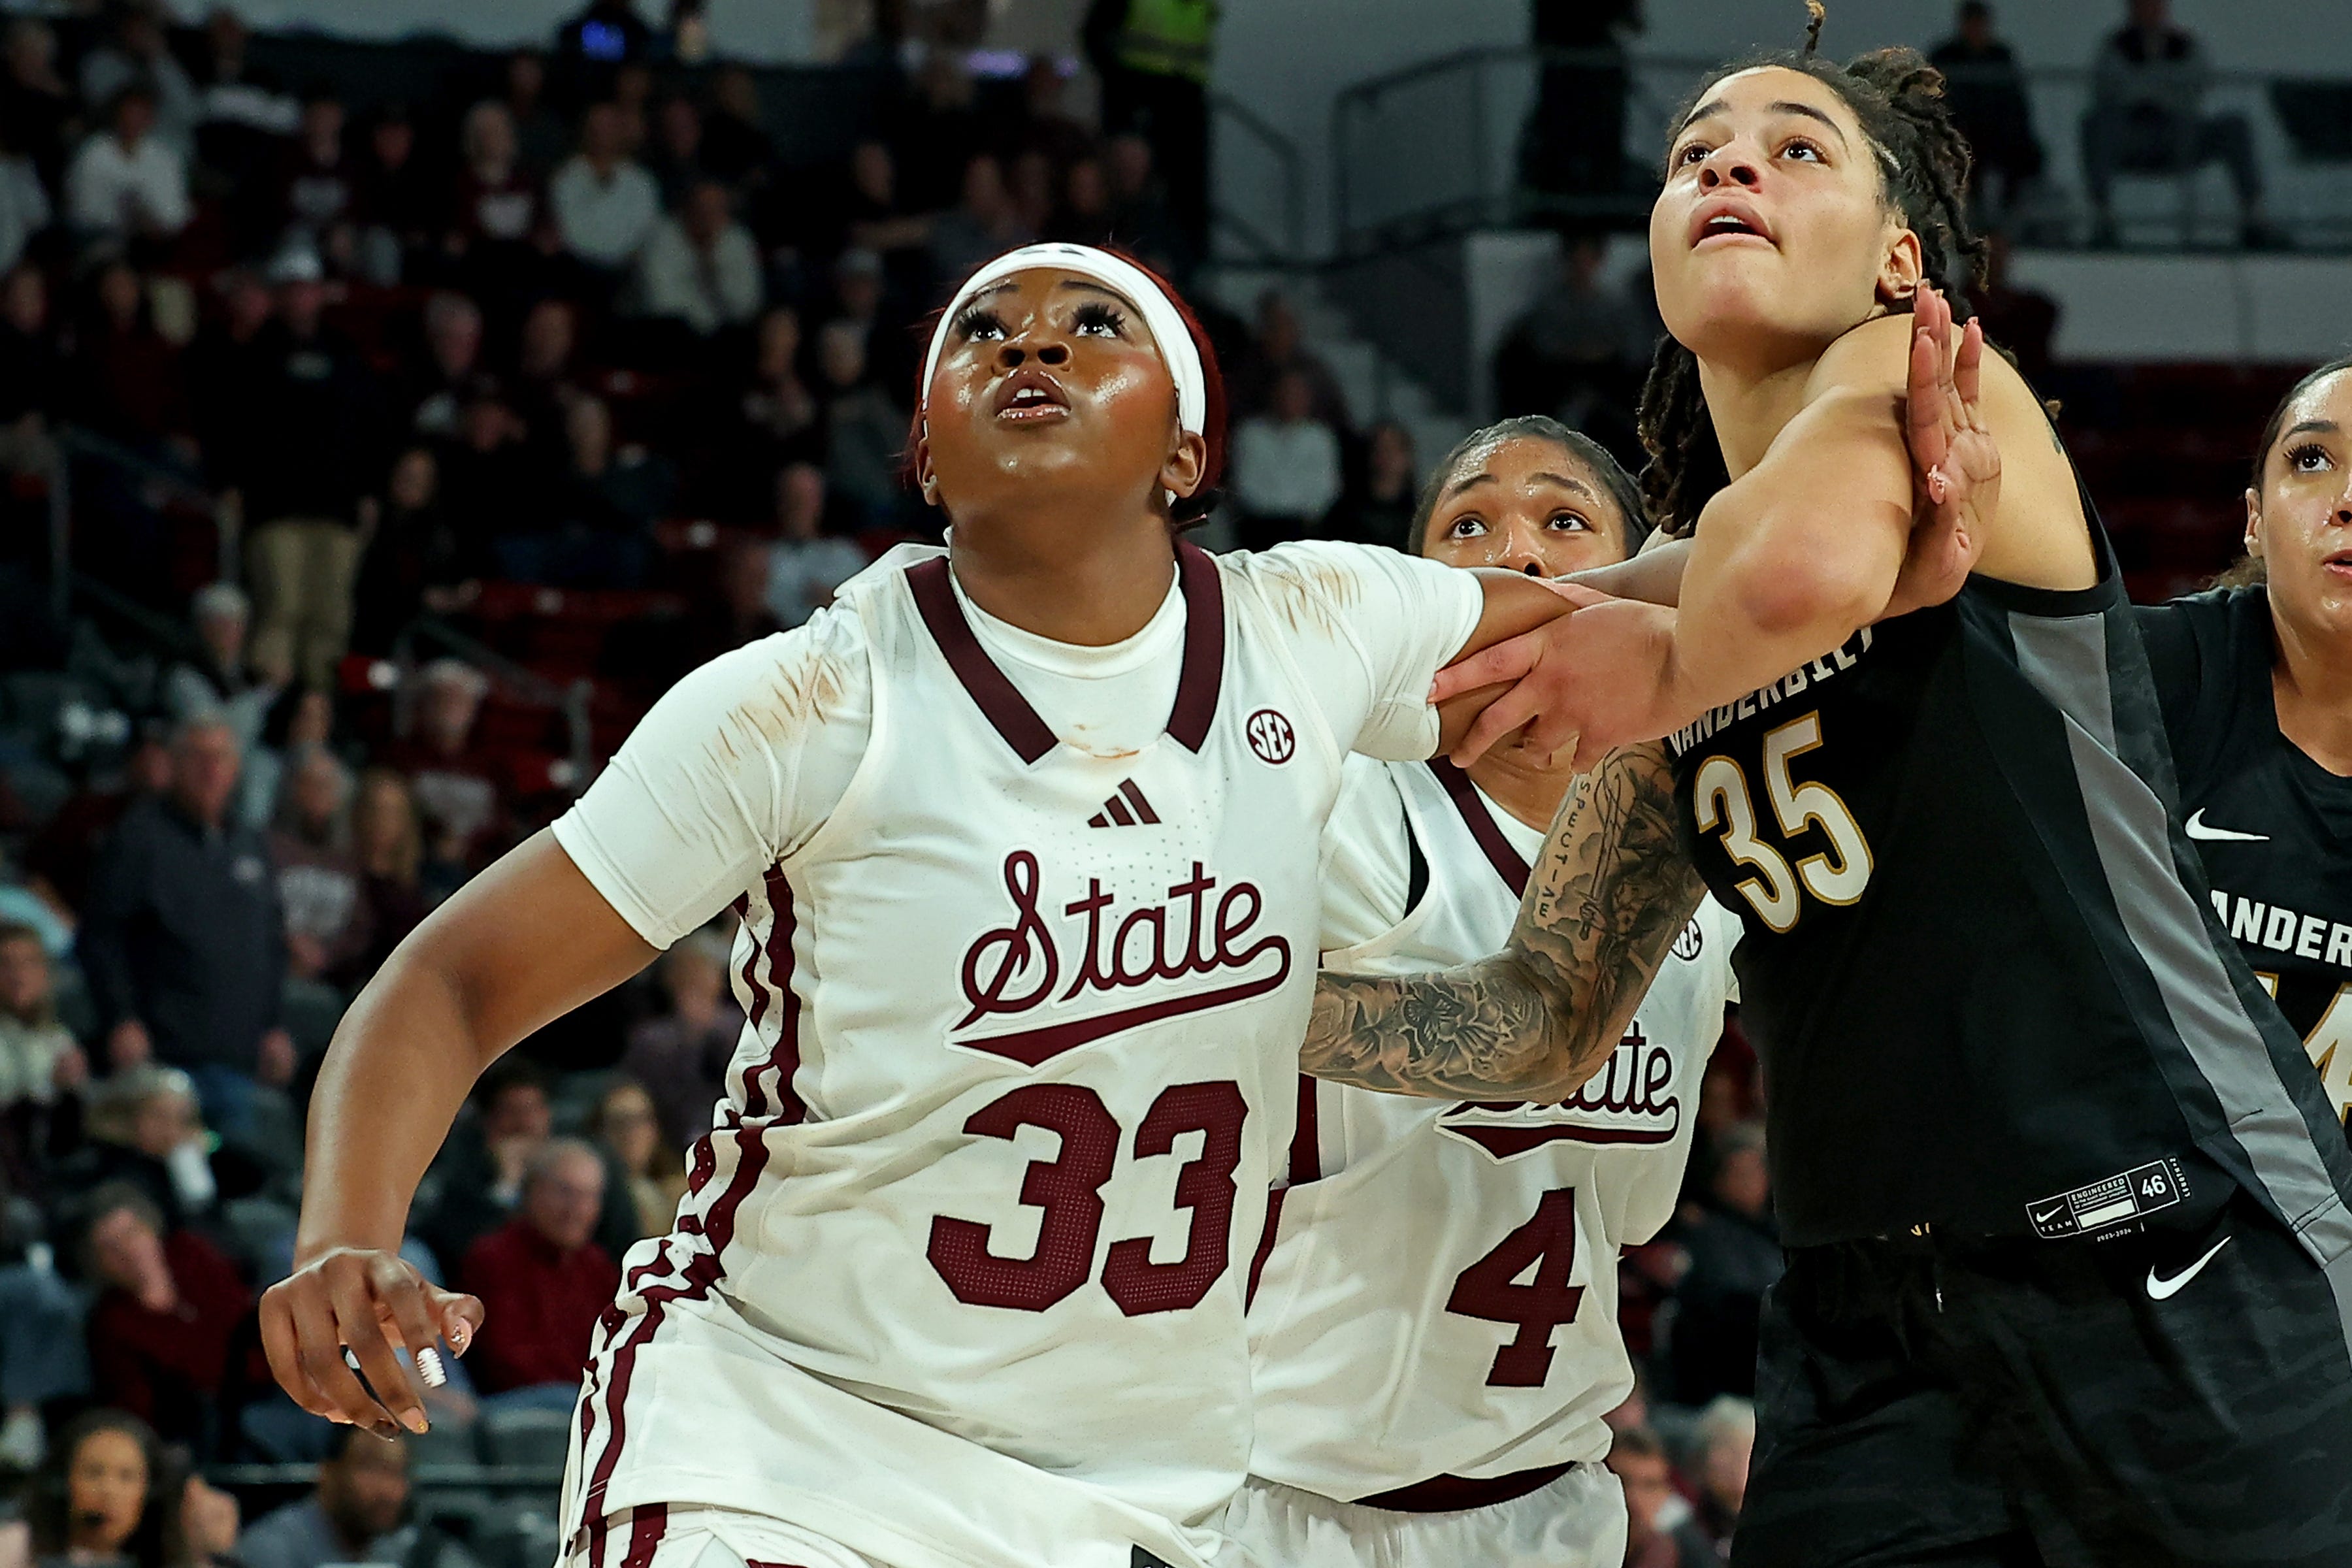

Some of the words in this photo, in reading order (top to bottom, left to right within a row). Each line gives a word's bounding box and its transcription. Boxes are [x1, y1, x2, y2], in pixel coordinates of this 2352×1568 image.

[1249, 713, 1292, 760] SEC
[1693, 709, 1874, 934] 35
[952, 849, 1264, 1032] State
[925, 1079, 1249, 1318] 33
[2040, 1220, 2073, 1233] TEAM
[2070, 1177, 2126, 1202] ENGINEERED
[2141, 1174, 2167, 1198] 46
[1444, 1185, 1586, 1388] 4
